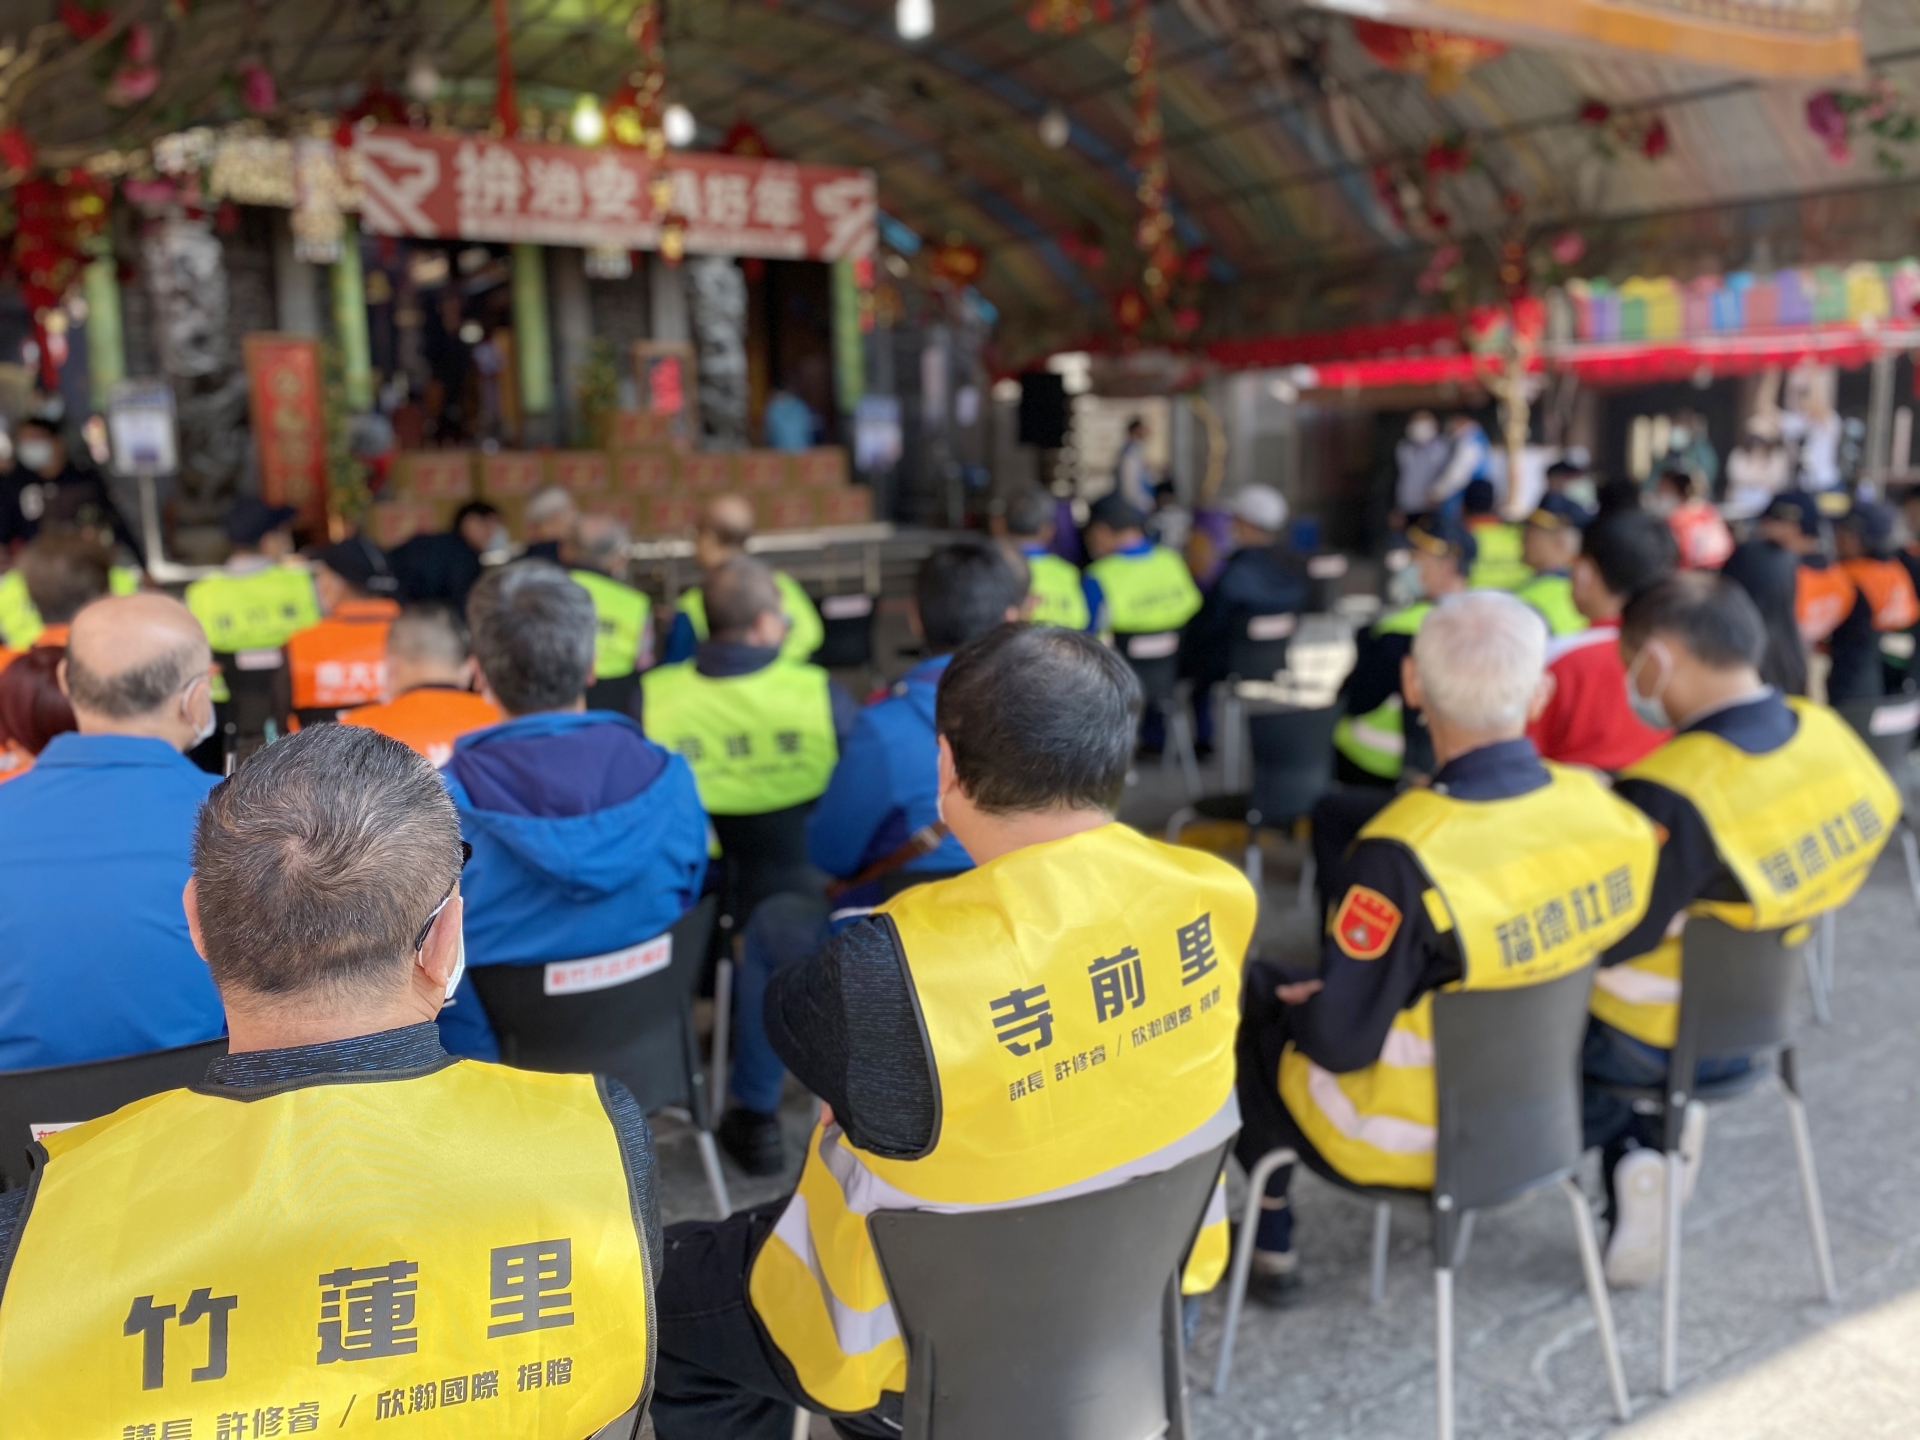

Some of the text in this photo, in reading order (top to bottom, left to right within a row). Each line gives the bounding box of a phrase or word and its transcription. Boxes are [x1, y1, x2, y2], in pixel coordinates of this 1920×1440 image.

[1758, 796, 1882, 897] 福德社區
[1494, 863, 1635, 969] 福德社區
[989, 911, 1218, 1057] 寺前里
[1008, 1070, 1045, 1101] 議長
[1054, 1045, 1106, 1081] 許修睿
[123, 1238, 576, 1391] 竹蓮里
[216, 1401, 320, 1440] 許修睿
[375, 1369, 499, 1421] 欣瀚國際
[516, 1357, 573, 1392] 捐贈
